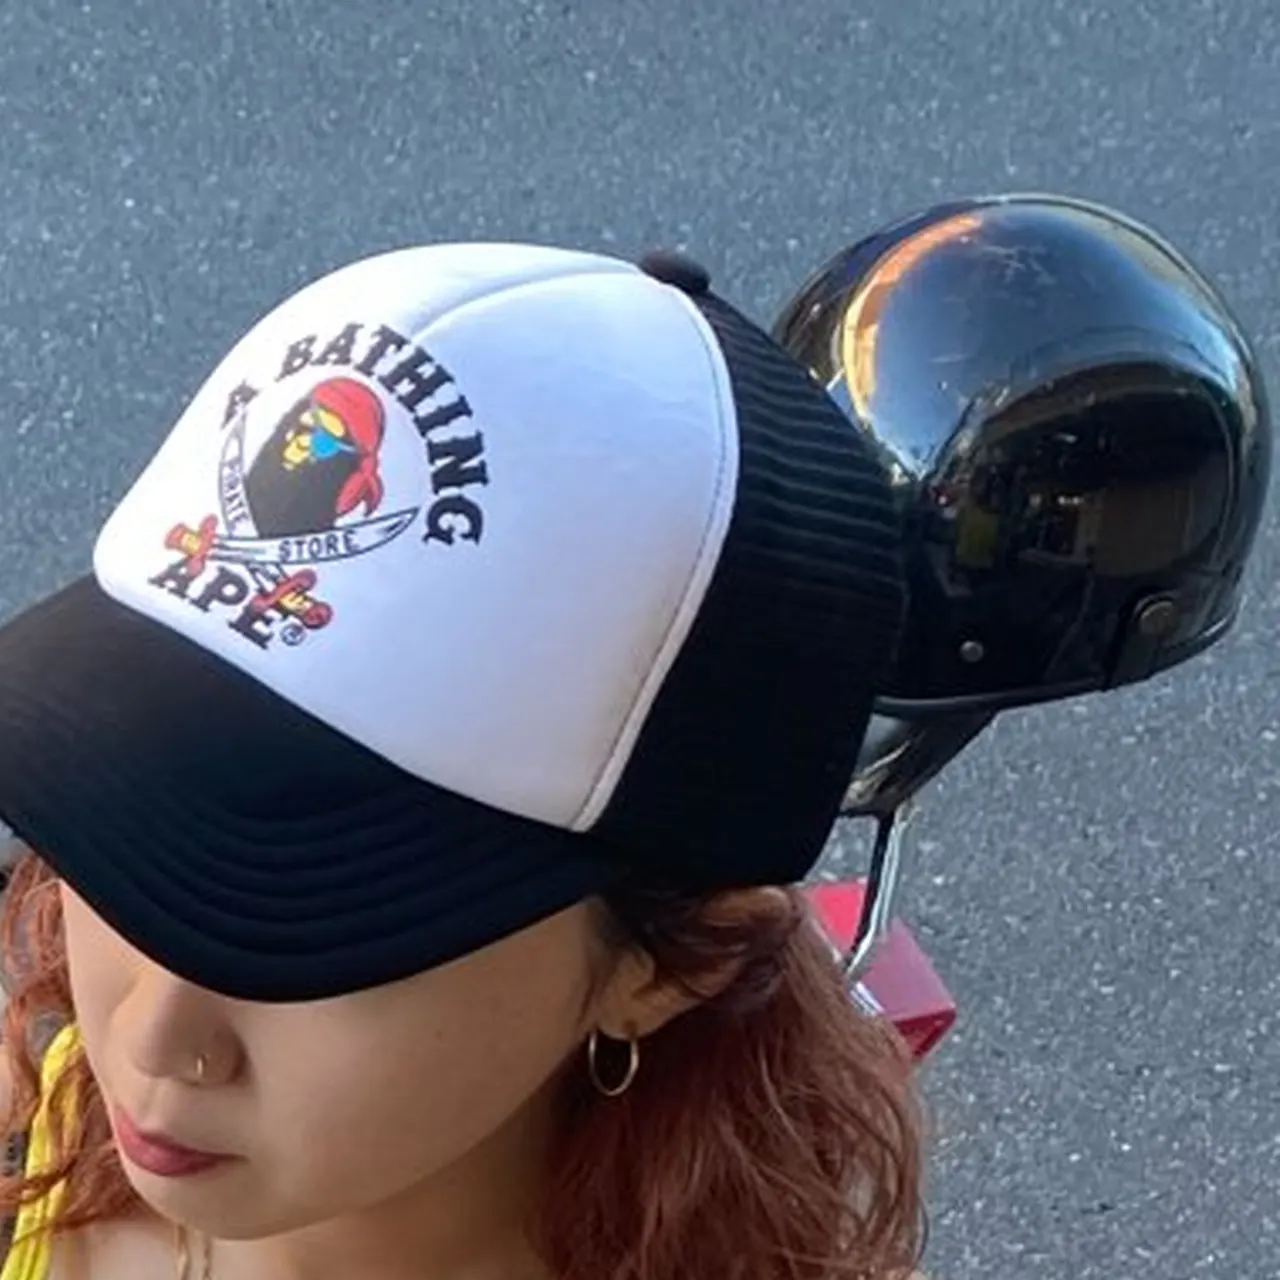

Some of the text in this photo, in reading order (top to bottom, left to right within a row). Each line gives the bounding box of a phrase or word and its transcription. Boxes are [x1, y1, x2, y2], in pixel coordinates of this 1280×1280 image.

[220, 322, 490, 546] A BATHING
[278, 529, 359, 563] STORE
